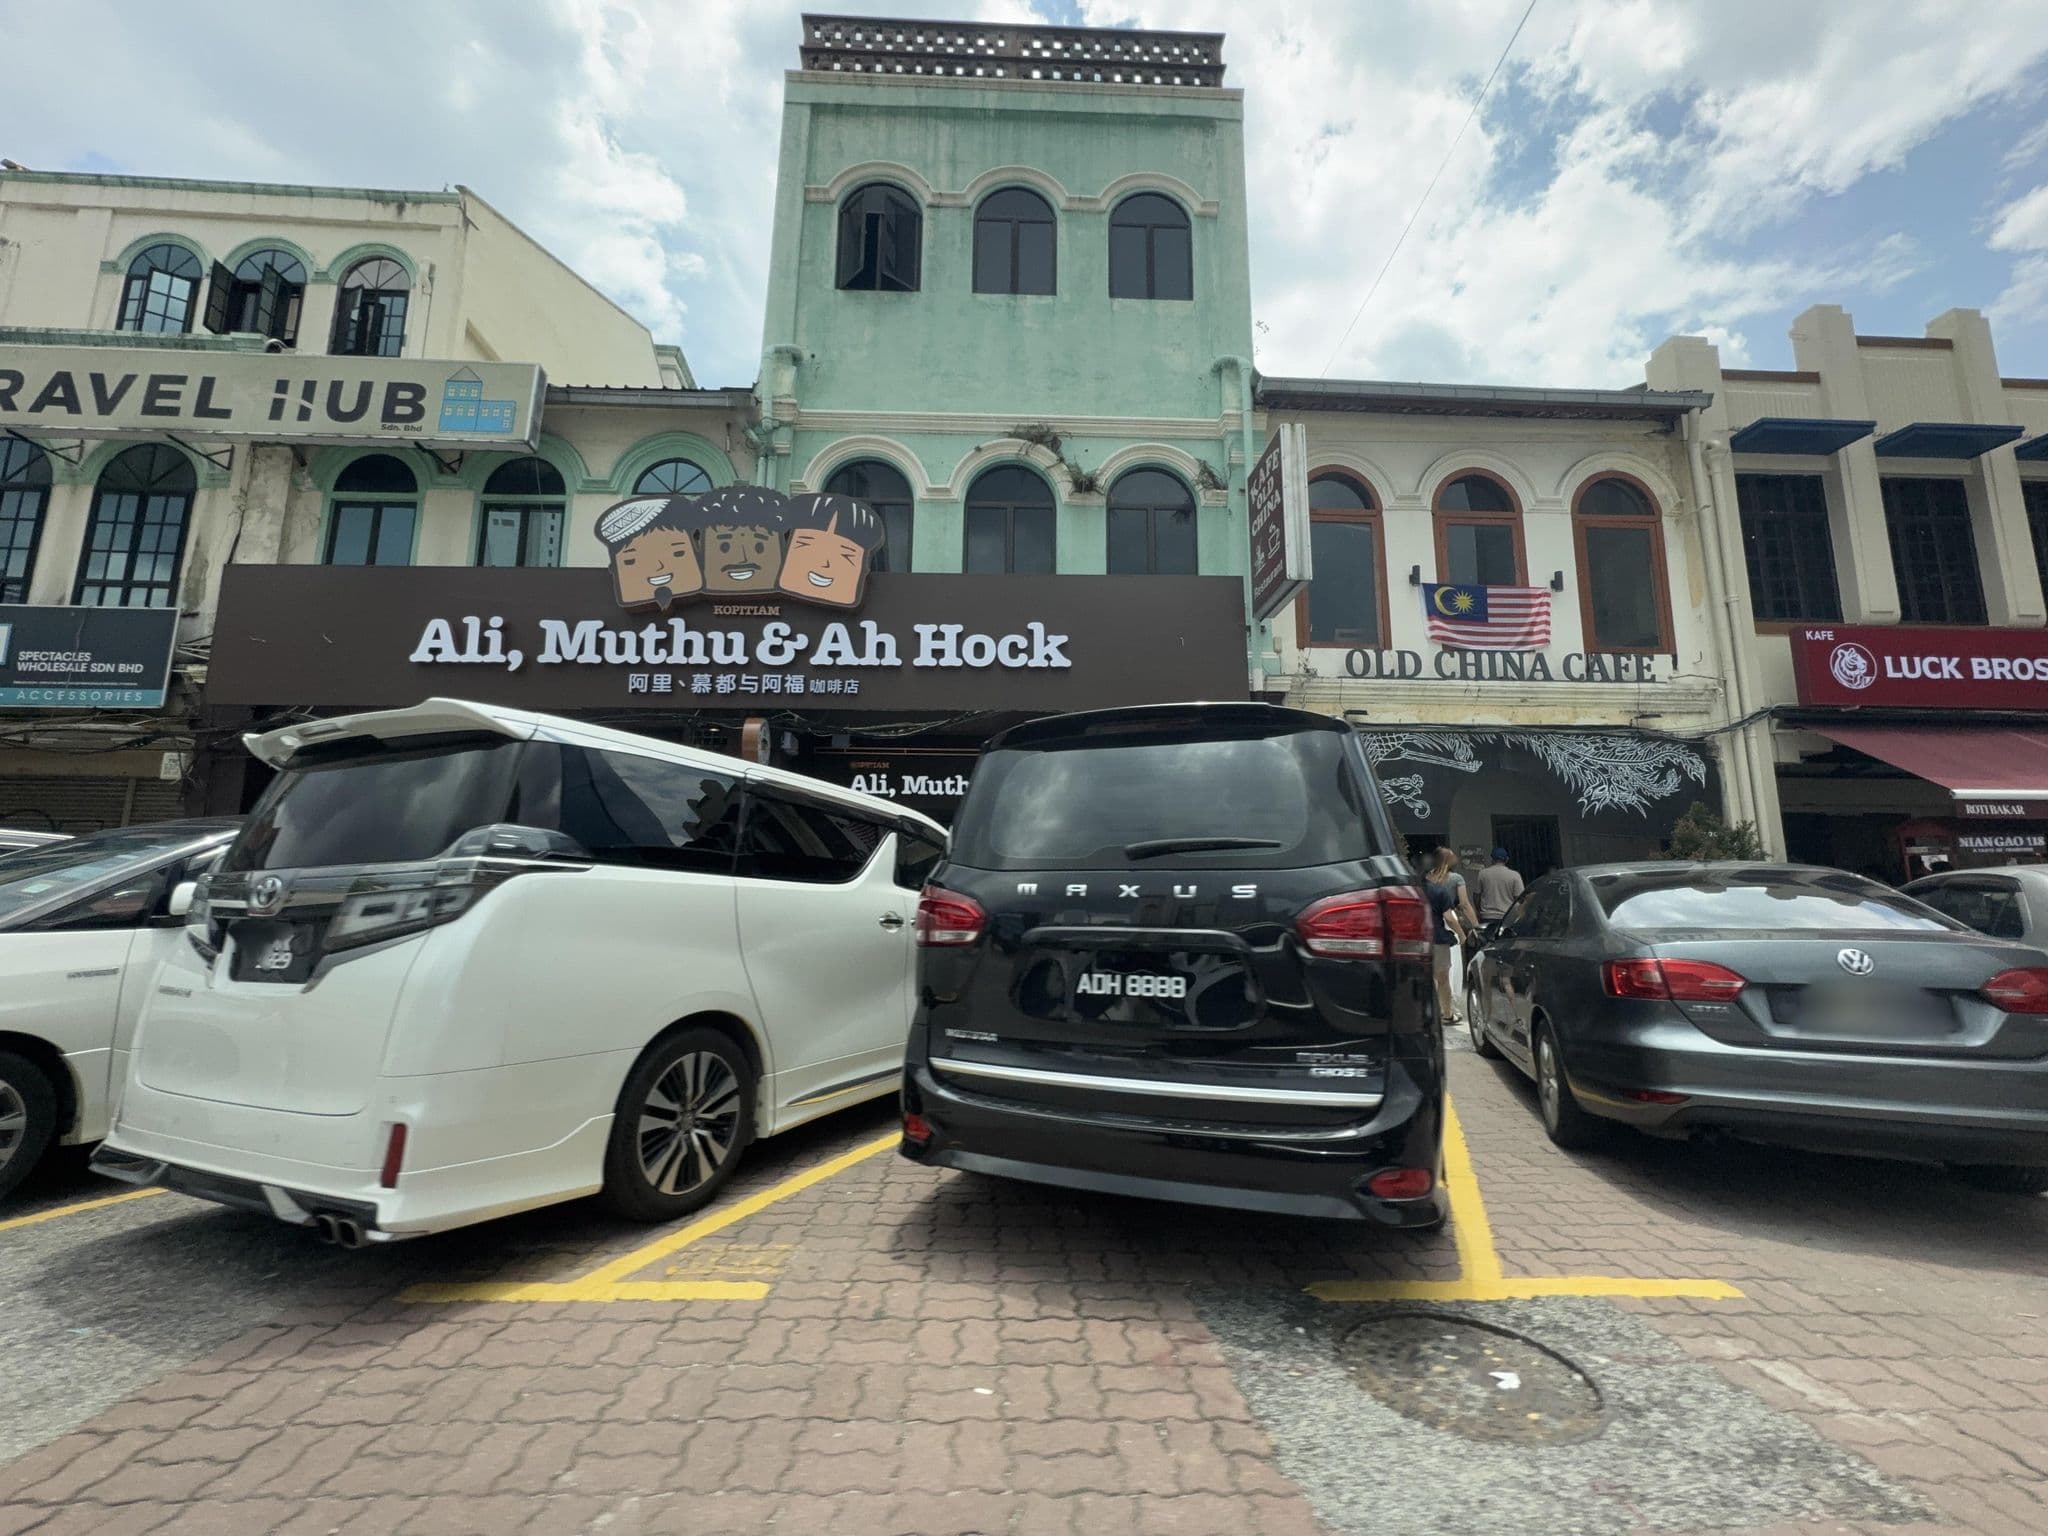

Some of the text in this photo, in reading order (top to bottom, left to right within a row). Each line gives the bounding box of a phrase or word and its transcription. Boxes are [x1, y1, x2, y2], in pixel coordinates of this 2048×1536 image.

[1250, 448, 1280, 504] KAFE
[1256, 476, 1275, 510] OLD
[1251, 489, 1281, 537] CHINA
[713, 605, 780, 615] KOPITIAM
[409, 616, 1073, 672] Ali, Muthu & Ah Hock
[1805, 630, 1834, 641] KAFE
[17, 662, 144, 674] WHOLESALE SDN BHD
[18, 651, 91, 662] SPECTACLES
[1345, 649, 1657, 683] OLD CHINA CAFE
[1884, 656, 2048, 681] LUCK BROS
[809, 679, 860, 694] 咖啡店
[850, 773, 897, 798] Ali,
[1017, 883, 1258, 898] MAXUS
[1076, 973, 1187, 998] ADH 8888
